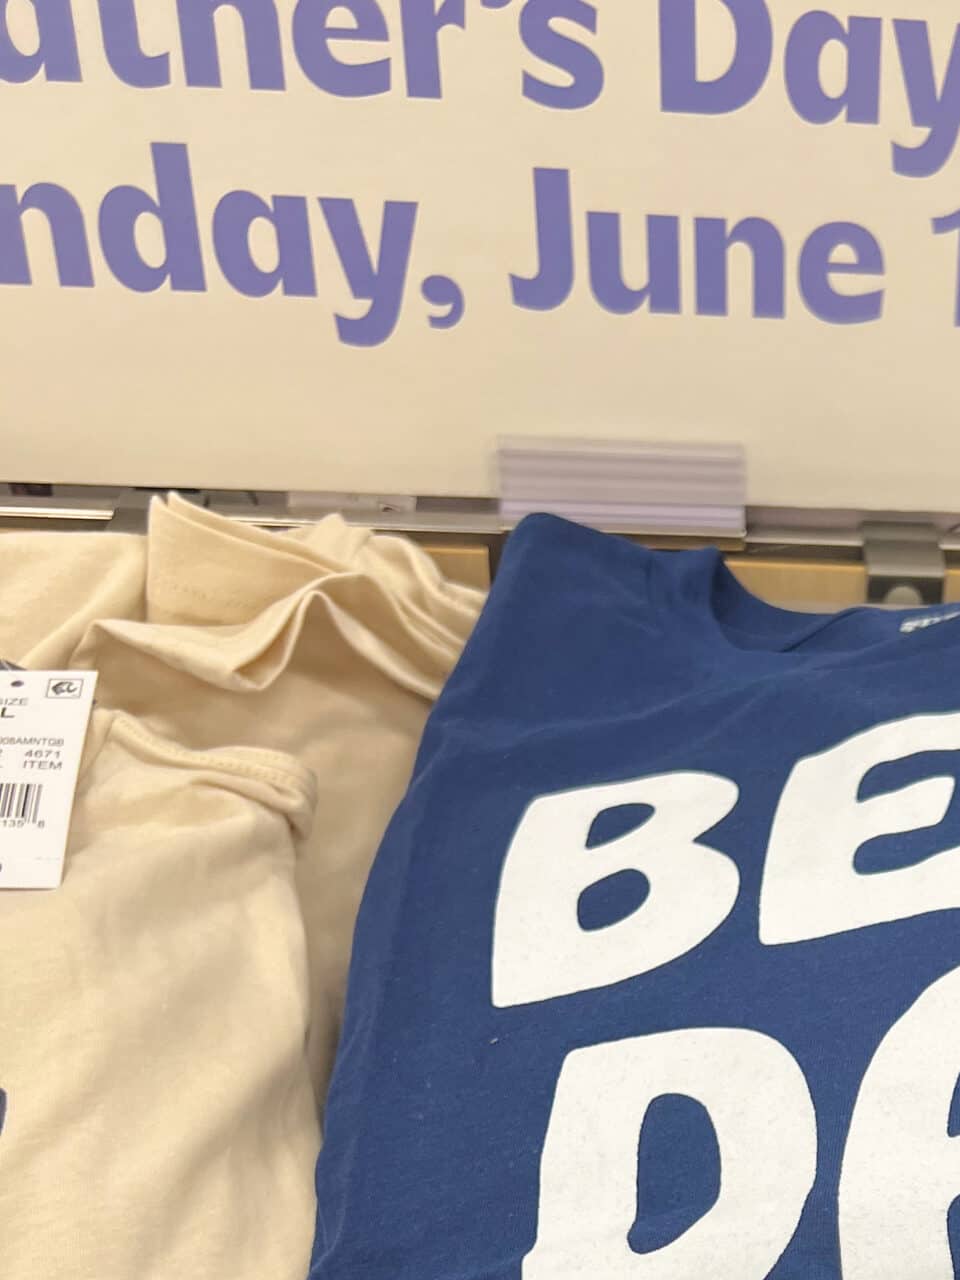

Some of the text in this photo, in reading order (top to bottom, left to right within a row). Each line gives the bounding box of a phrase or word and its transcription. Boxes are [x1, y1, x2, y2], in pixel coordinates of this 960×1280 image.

[0, 142, 465, 347] nday,
[509, 166, 886, 325] June
[22, 760, 63, 770] ITEM
